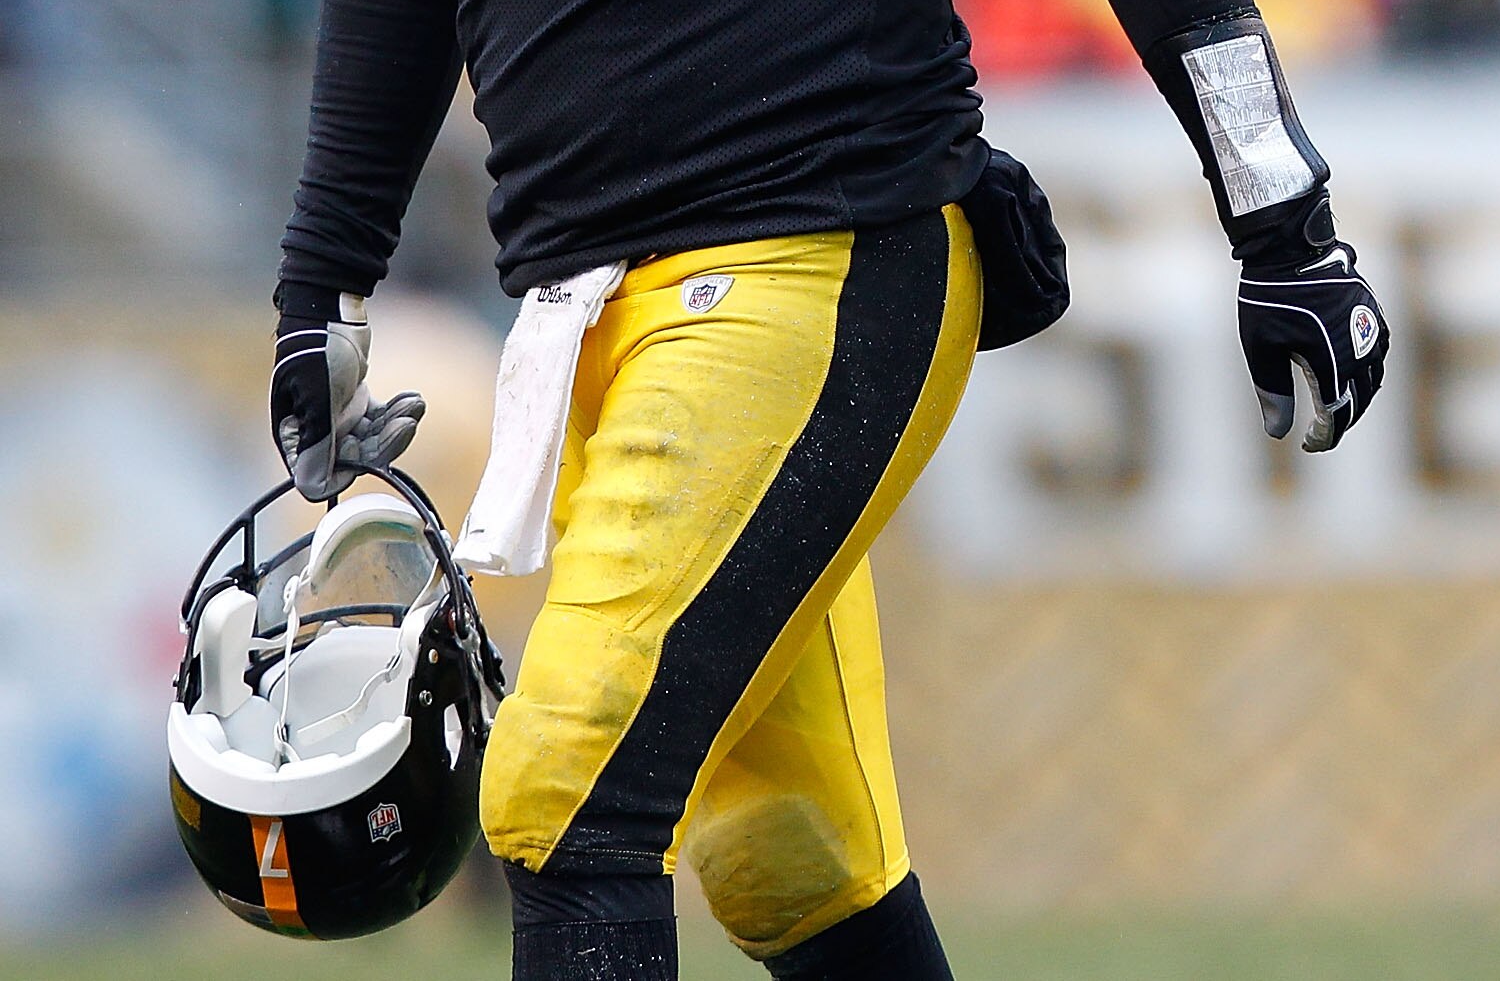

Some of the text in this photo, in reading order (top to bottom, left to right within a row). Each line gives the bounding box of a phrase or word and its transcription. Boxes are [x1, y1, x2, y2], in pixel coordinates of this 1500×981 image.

[537, 285, 572, 305] Wilson
[690, 293, 710, 306] NFL
[371, 808, 396, 828] NFL
[259, 821, 288, 878] 7
